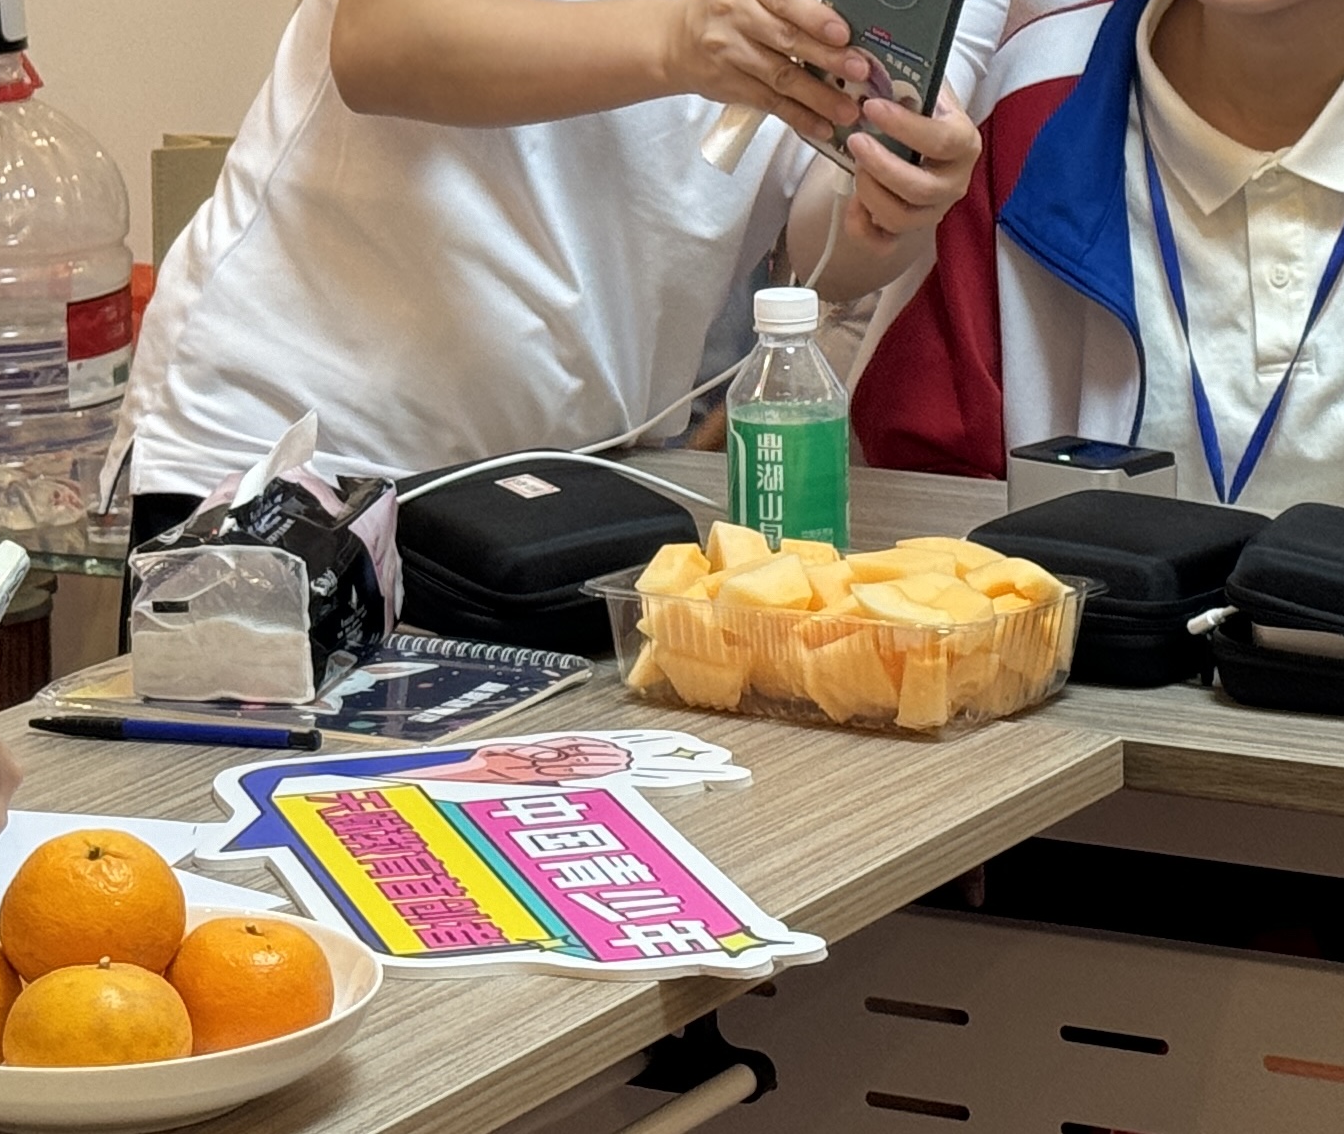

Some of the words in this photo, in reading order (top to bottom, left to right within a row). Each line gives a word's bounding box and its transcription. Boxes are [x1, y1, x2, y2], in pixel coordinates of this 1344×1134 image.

[304, 789, 511, 950] 天赋教育首创者
[488, 794, 725, 958] 中国青少年
